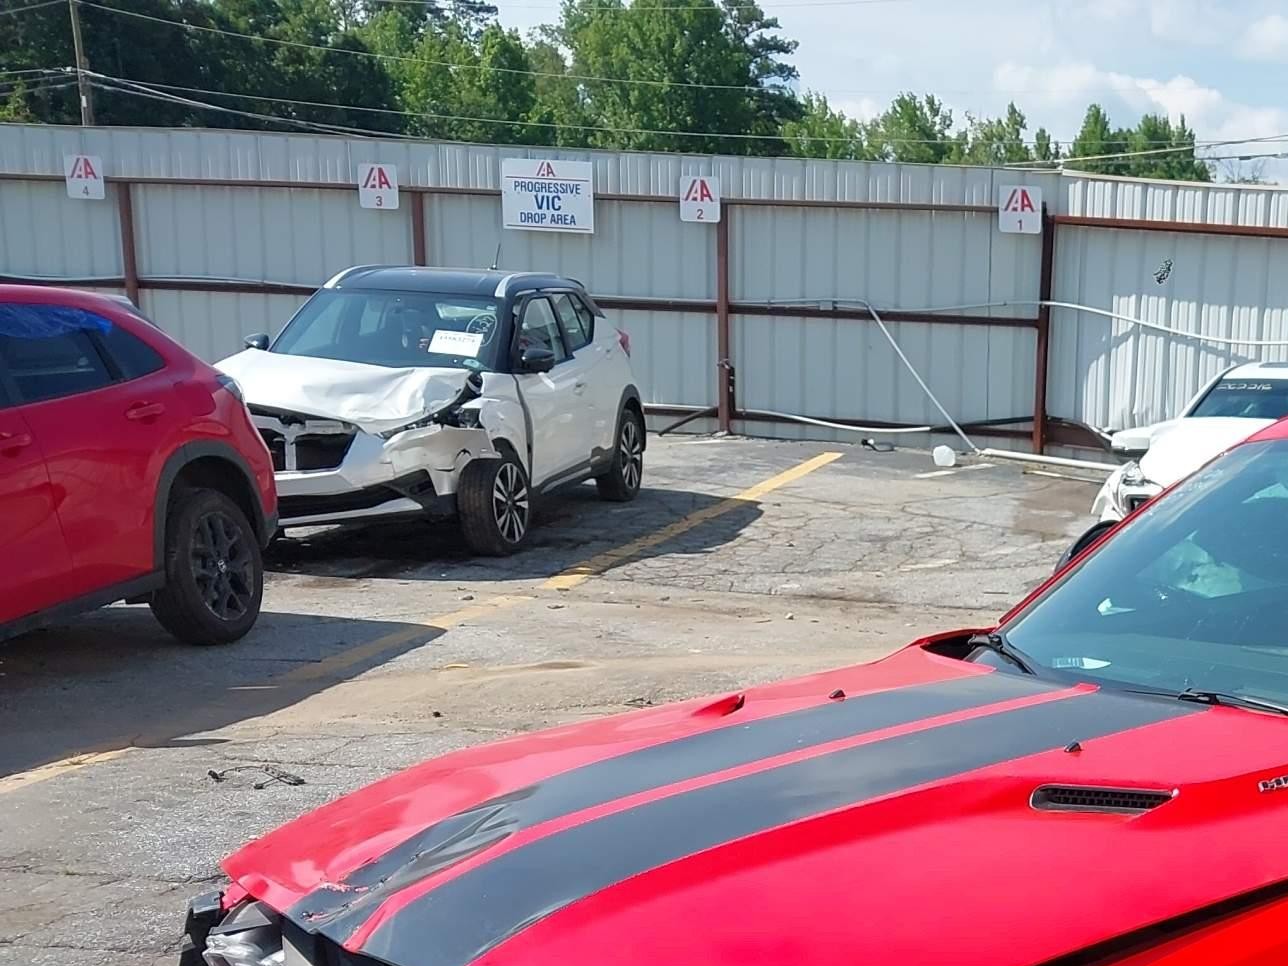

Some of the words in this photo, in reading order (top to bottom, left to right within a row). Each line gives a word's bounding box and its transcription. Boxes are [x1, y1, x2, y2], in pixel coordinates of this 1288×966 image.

[82, 185, 90, 197] 4
[513, 180, 582, 195] PROGRESSIVE
[375, 195, 383, 207] 3
[534, 194, 562, 211] VIC
[519, 211, 547, 224] DROP
[550, 213, 577, 226] AREA
[696, 208, 704, 220] 2
[1017, 219, 1023, 231] 1
